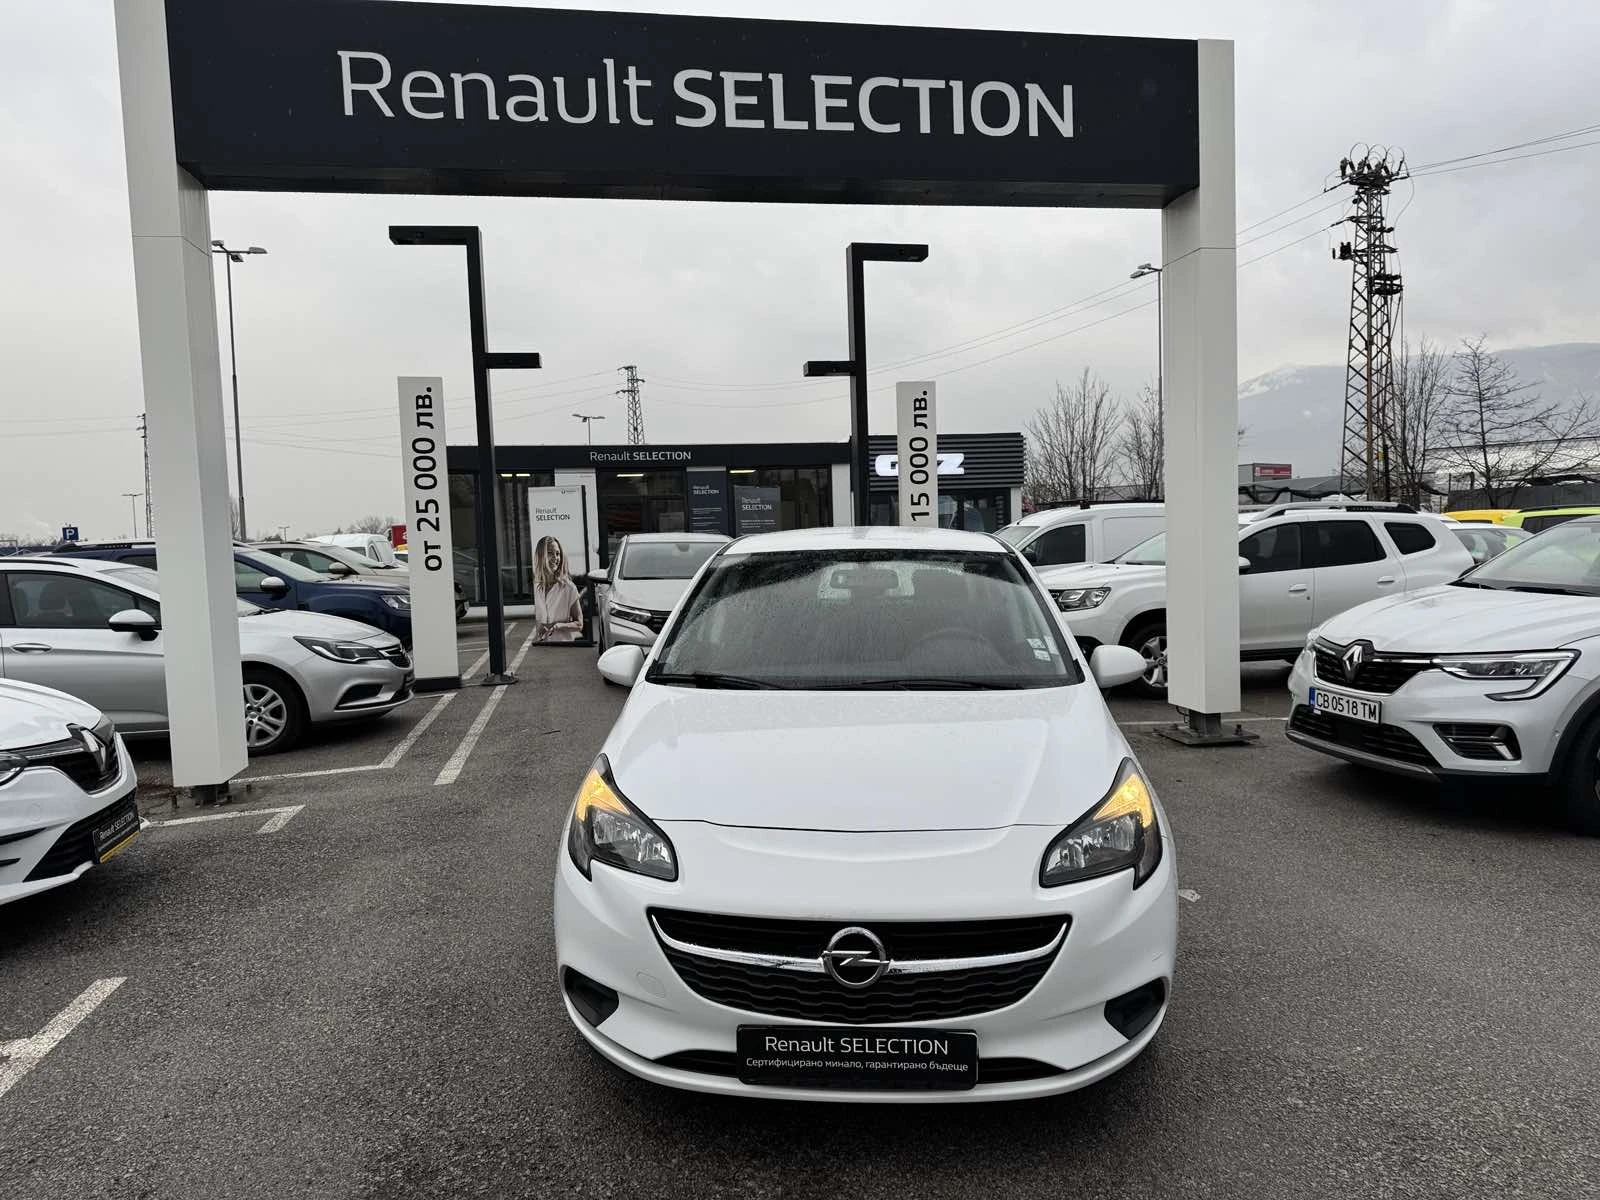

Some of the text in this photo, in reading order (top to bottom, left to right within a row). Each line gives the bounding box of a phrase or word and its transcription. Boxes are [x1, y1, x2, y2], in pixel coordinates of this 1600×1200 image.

[337, 50, 1074, 138] Renault SELECTION
[590, 451, 691, 461] Renault SELECTION
[909, 390, 930, 522] 15 000 лв.
[412, 386, 442, 571] от 25 000 лв.
[1316, 692, 1377, 720] CB 0518 TM
[765, 1036, 949, 1055] Renault SELECTION
[746, 1057, 969, 1072] Сертифицирано минало, гарантирано бъдеще
